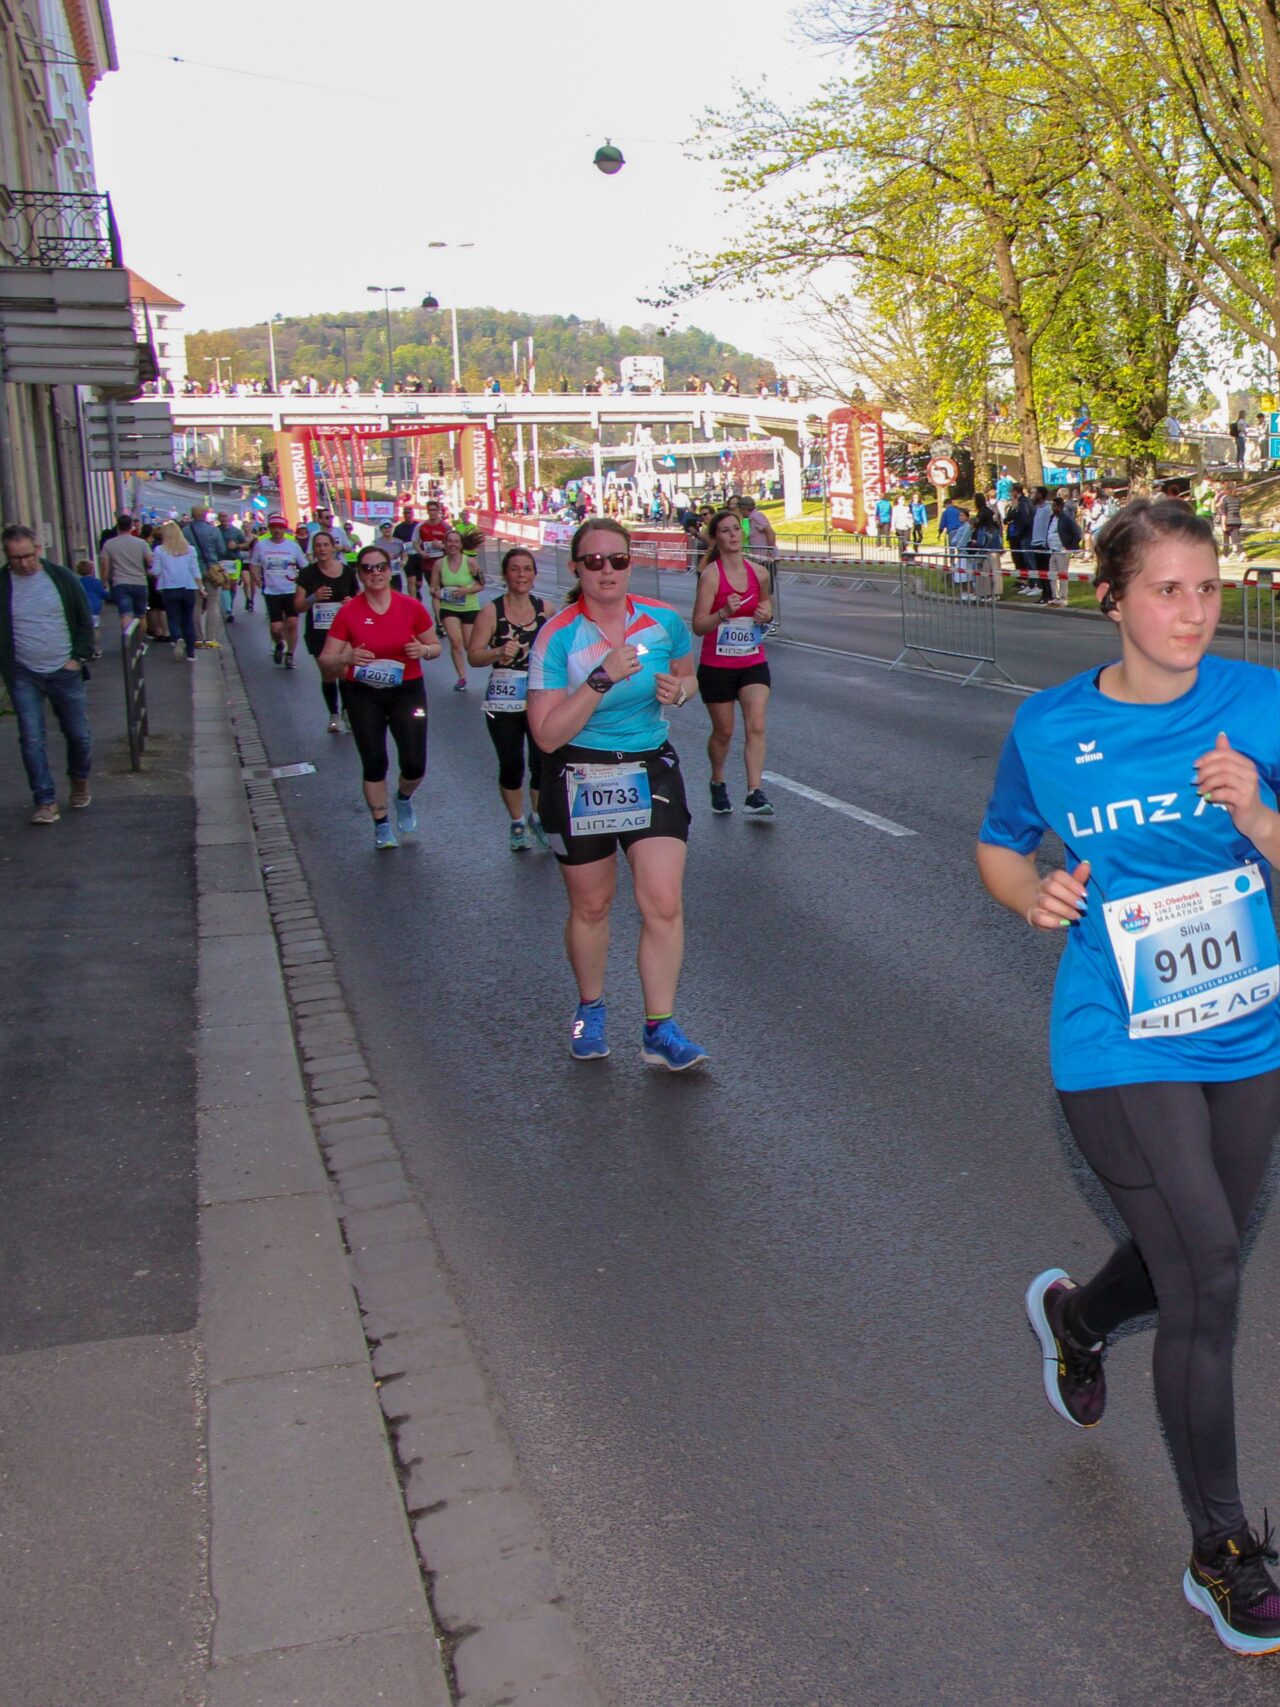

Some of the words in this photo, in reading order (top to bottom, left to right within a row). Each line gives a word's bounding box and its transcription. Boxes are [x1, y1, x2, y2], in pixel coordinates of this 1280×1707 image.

[290, 442, 310, 505] GENERALI
[724, 631, 755, 642] 10063
[361, 669, 396, 684] 12078
[489, 685, 517, 696] 8542
[1075, 751, 1104, 765] erima
[580, 787, 640, 807] 10733
[621, 816, 646, 827] AG
[1153, 901, 1165, 910] 22.
[1165, 891, 1201, 906] Oberbank
[1154, 906, 1172, 916] LINZ
[1175, 899, 1203, 911] DONAU
[1156, 905, 1205, 923] MARATHON
[1180, 922, 1212, 938] Silvia
[1154, 930, 1243, 984] 9101
[1186, 966, 1259, 997] VIERTELMARATHON
[1227, 982, 1271, 1013] AG
